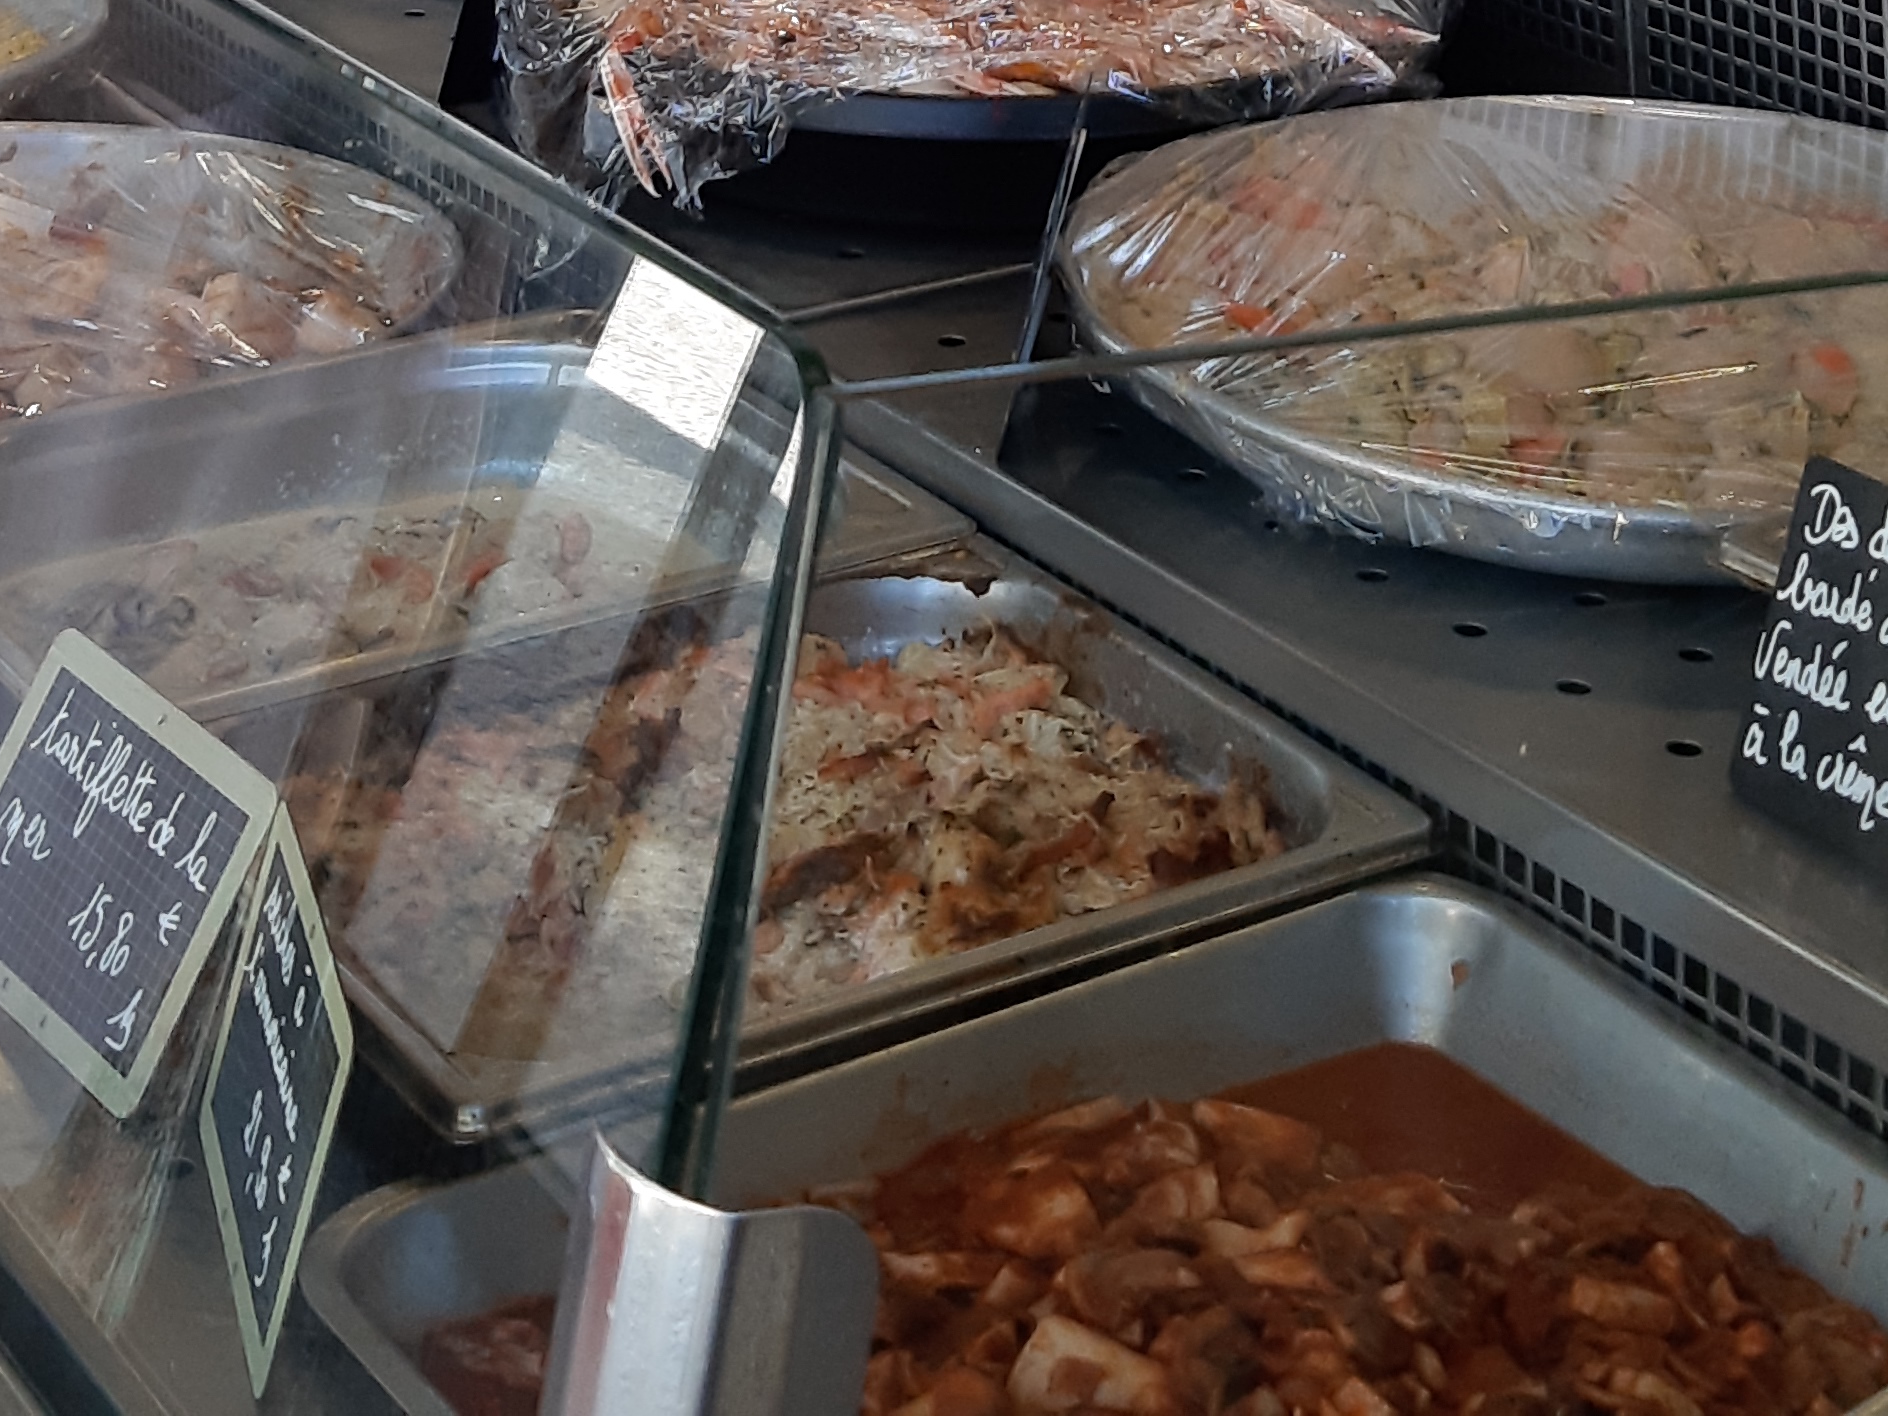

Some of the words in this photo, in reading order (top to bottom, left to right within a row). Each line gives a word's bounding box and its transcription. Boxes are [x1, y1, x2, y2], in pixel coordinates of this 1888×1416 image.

[1803, 482, 1860, 549] Dos
[1776, 551, 1879, 632] bardé
[1753, 620, 1851, 712] Vendée
[1742, 703, 1769, 765] à
[1779, 709, 1808, 781] la
[147, 792, 185, 857] de
[174, 810, 218, 893] la
[68, 882, 135, 977] 15,80
[157, 901, 184, 946] €
